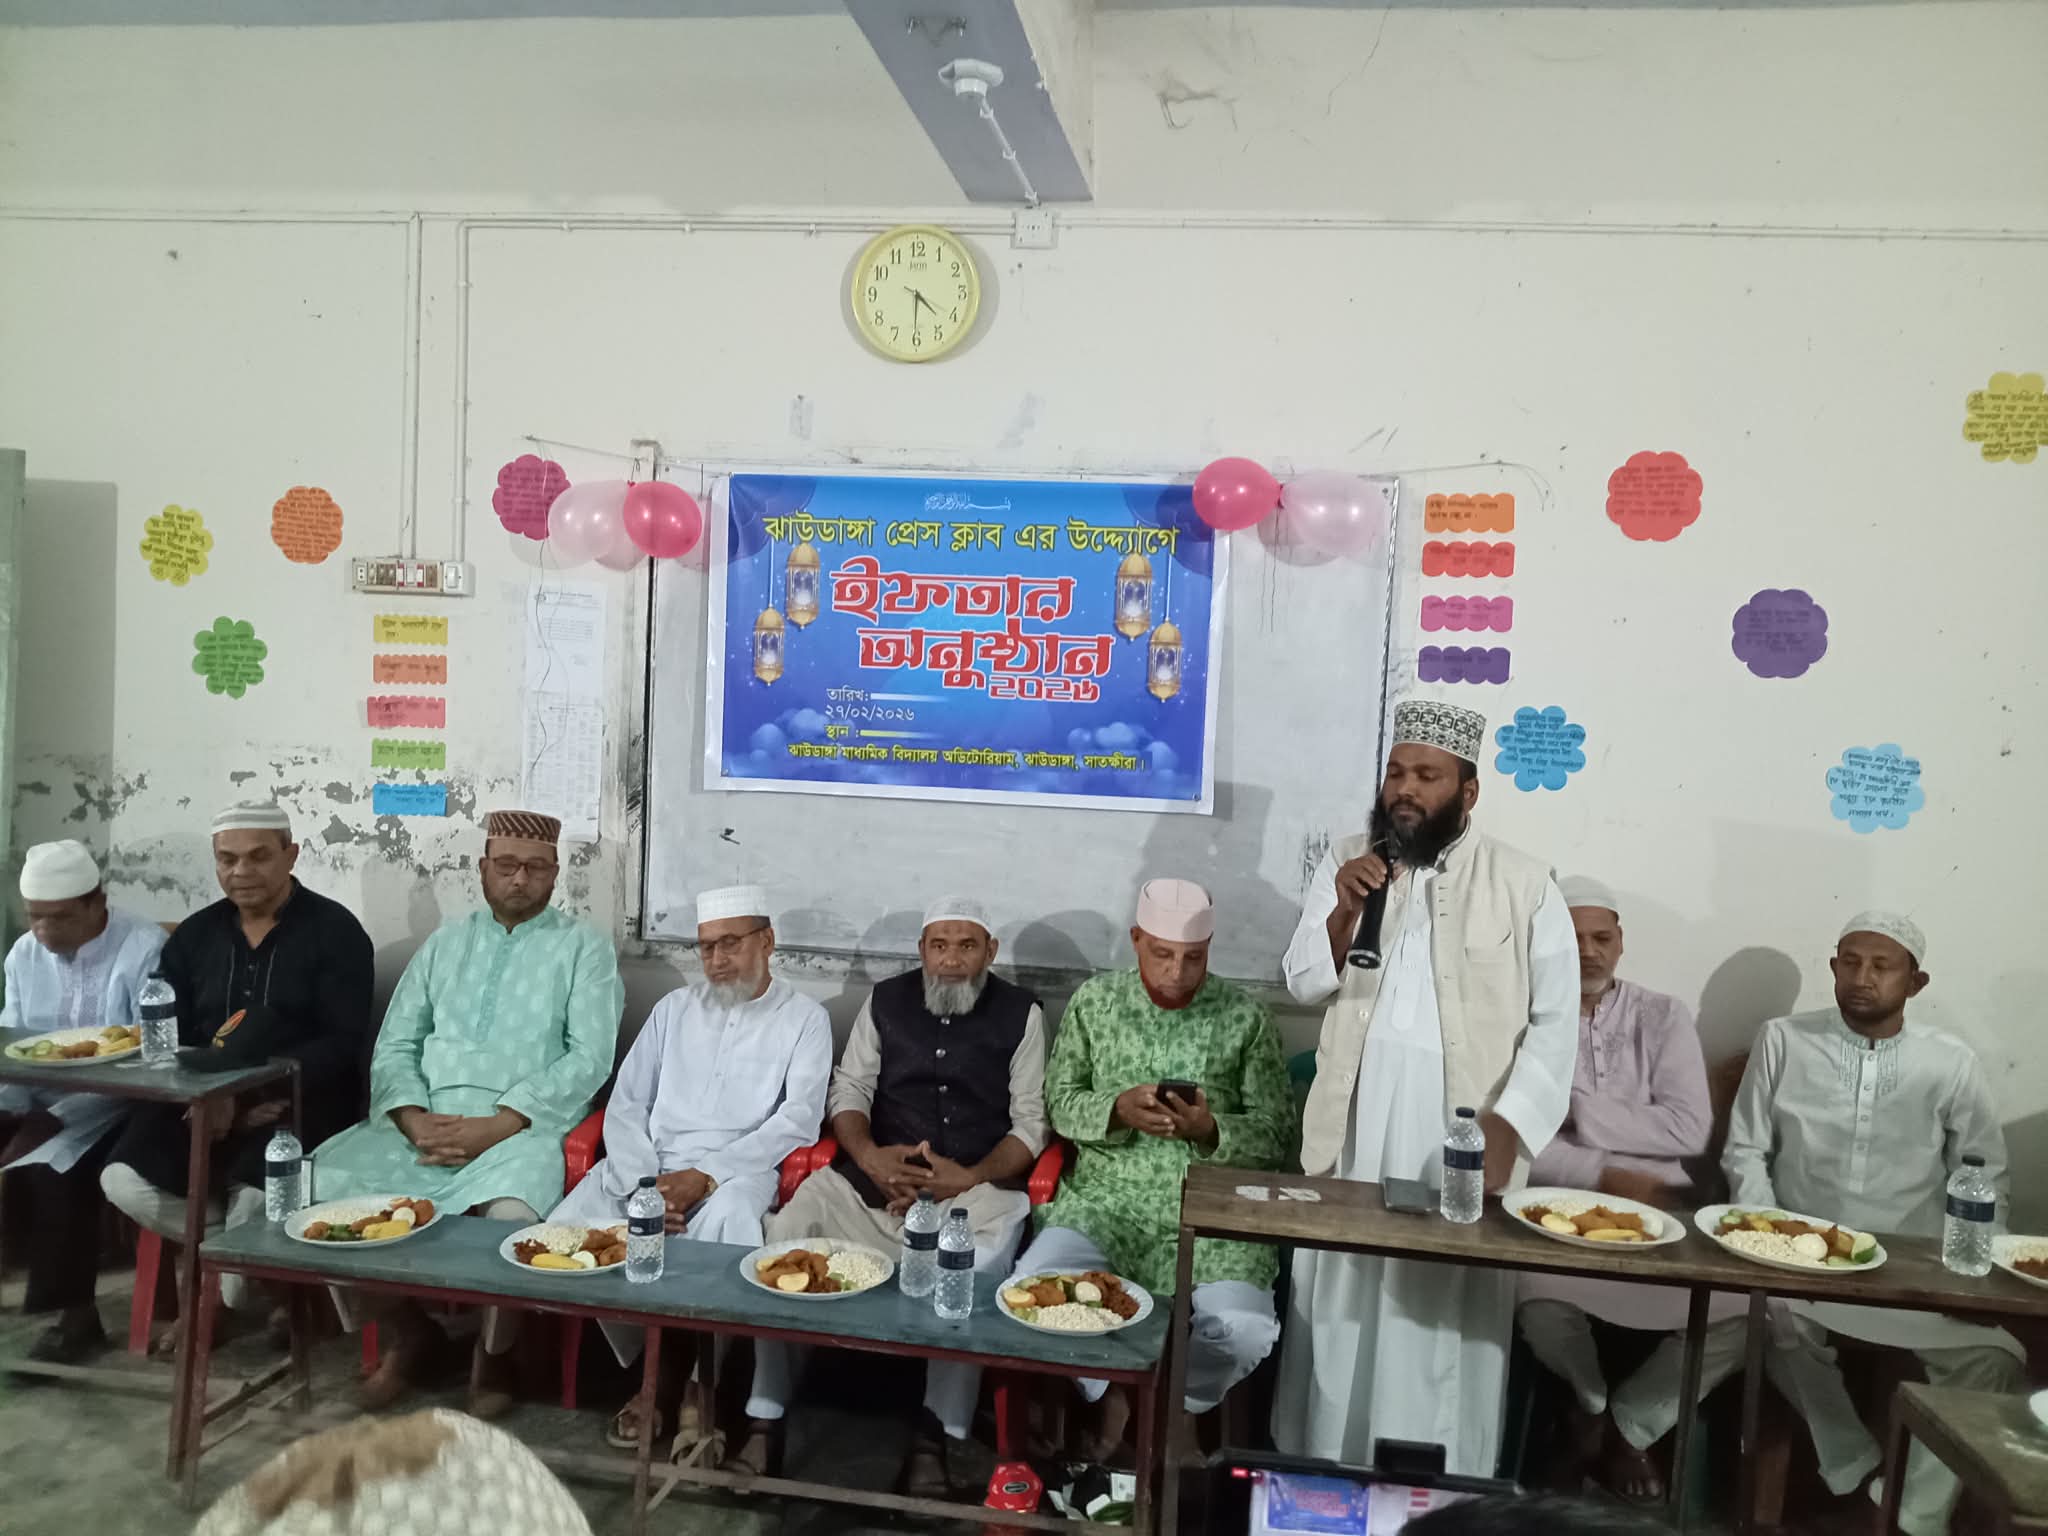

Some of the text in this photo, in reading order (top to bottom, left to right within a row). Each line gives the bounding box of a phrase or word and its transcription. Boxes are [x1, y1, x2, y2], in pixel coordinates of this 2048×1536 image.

[890, 248, 901, 265] 11
[911, 241, 926, 258] 12
[936, 245, 942, 262] 1
[874, 265, 889, 281] 10
[951, 262, 961, 278] 2
[868, 286, 878, 303] 9
[958, 285, 967, 301] 3
[874, 310, 884, 326] 8
[949, 306, 958, 323] 4
[890, 326, 899, 342] 7
[912, 331, 921, 347] 6
[934, 324, 943, 341] 5
[762, 510, 877, 546] ঝাউডাঙ্গা
[886, 518, 944, 548] প্রেস
[949, 519, 1005, 551] ক্লাব
[1014, 521, 1059, 552] এর
[829, 555, 1077, 626] ইফতার
[857, 617, 1116, 690] অনুষ্ঠান
[826, 685, 870, 702] তারিখ:
[988, 675, 1100, 704] ২০২৬
[825, 703, 915, 721] ২৭/০২/২০২৬
[824, 723, 849, 740] স্থান
[787, 742, 837, 760] ঝাউডাঙ্গা
[841, 743, 889, 761] মাধ্যমিক
[892, 745, 938, 763] বিদ্যালয়
